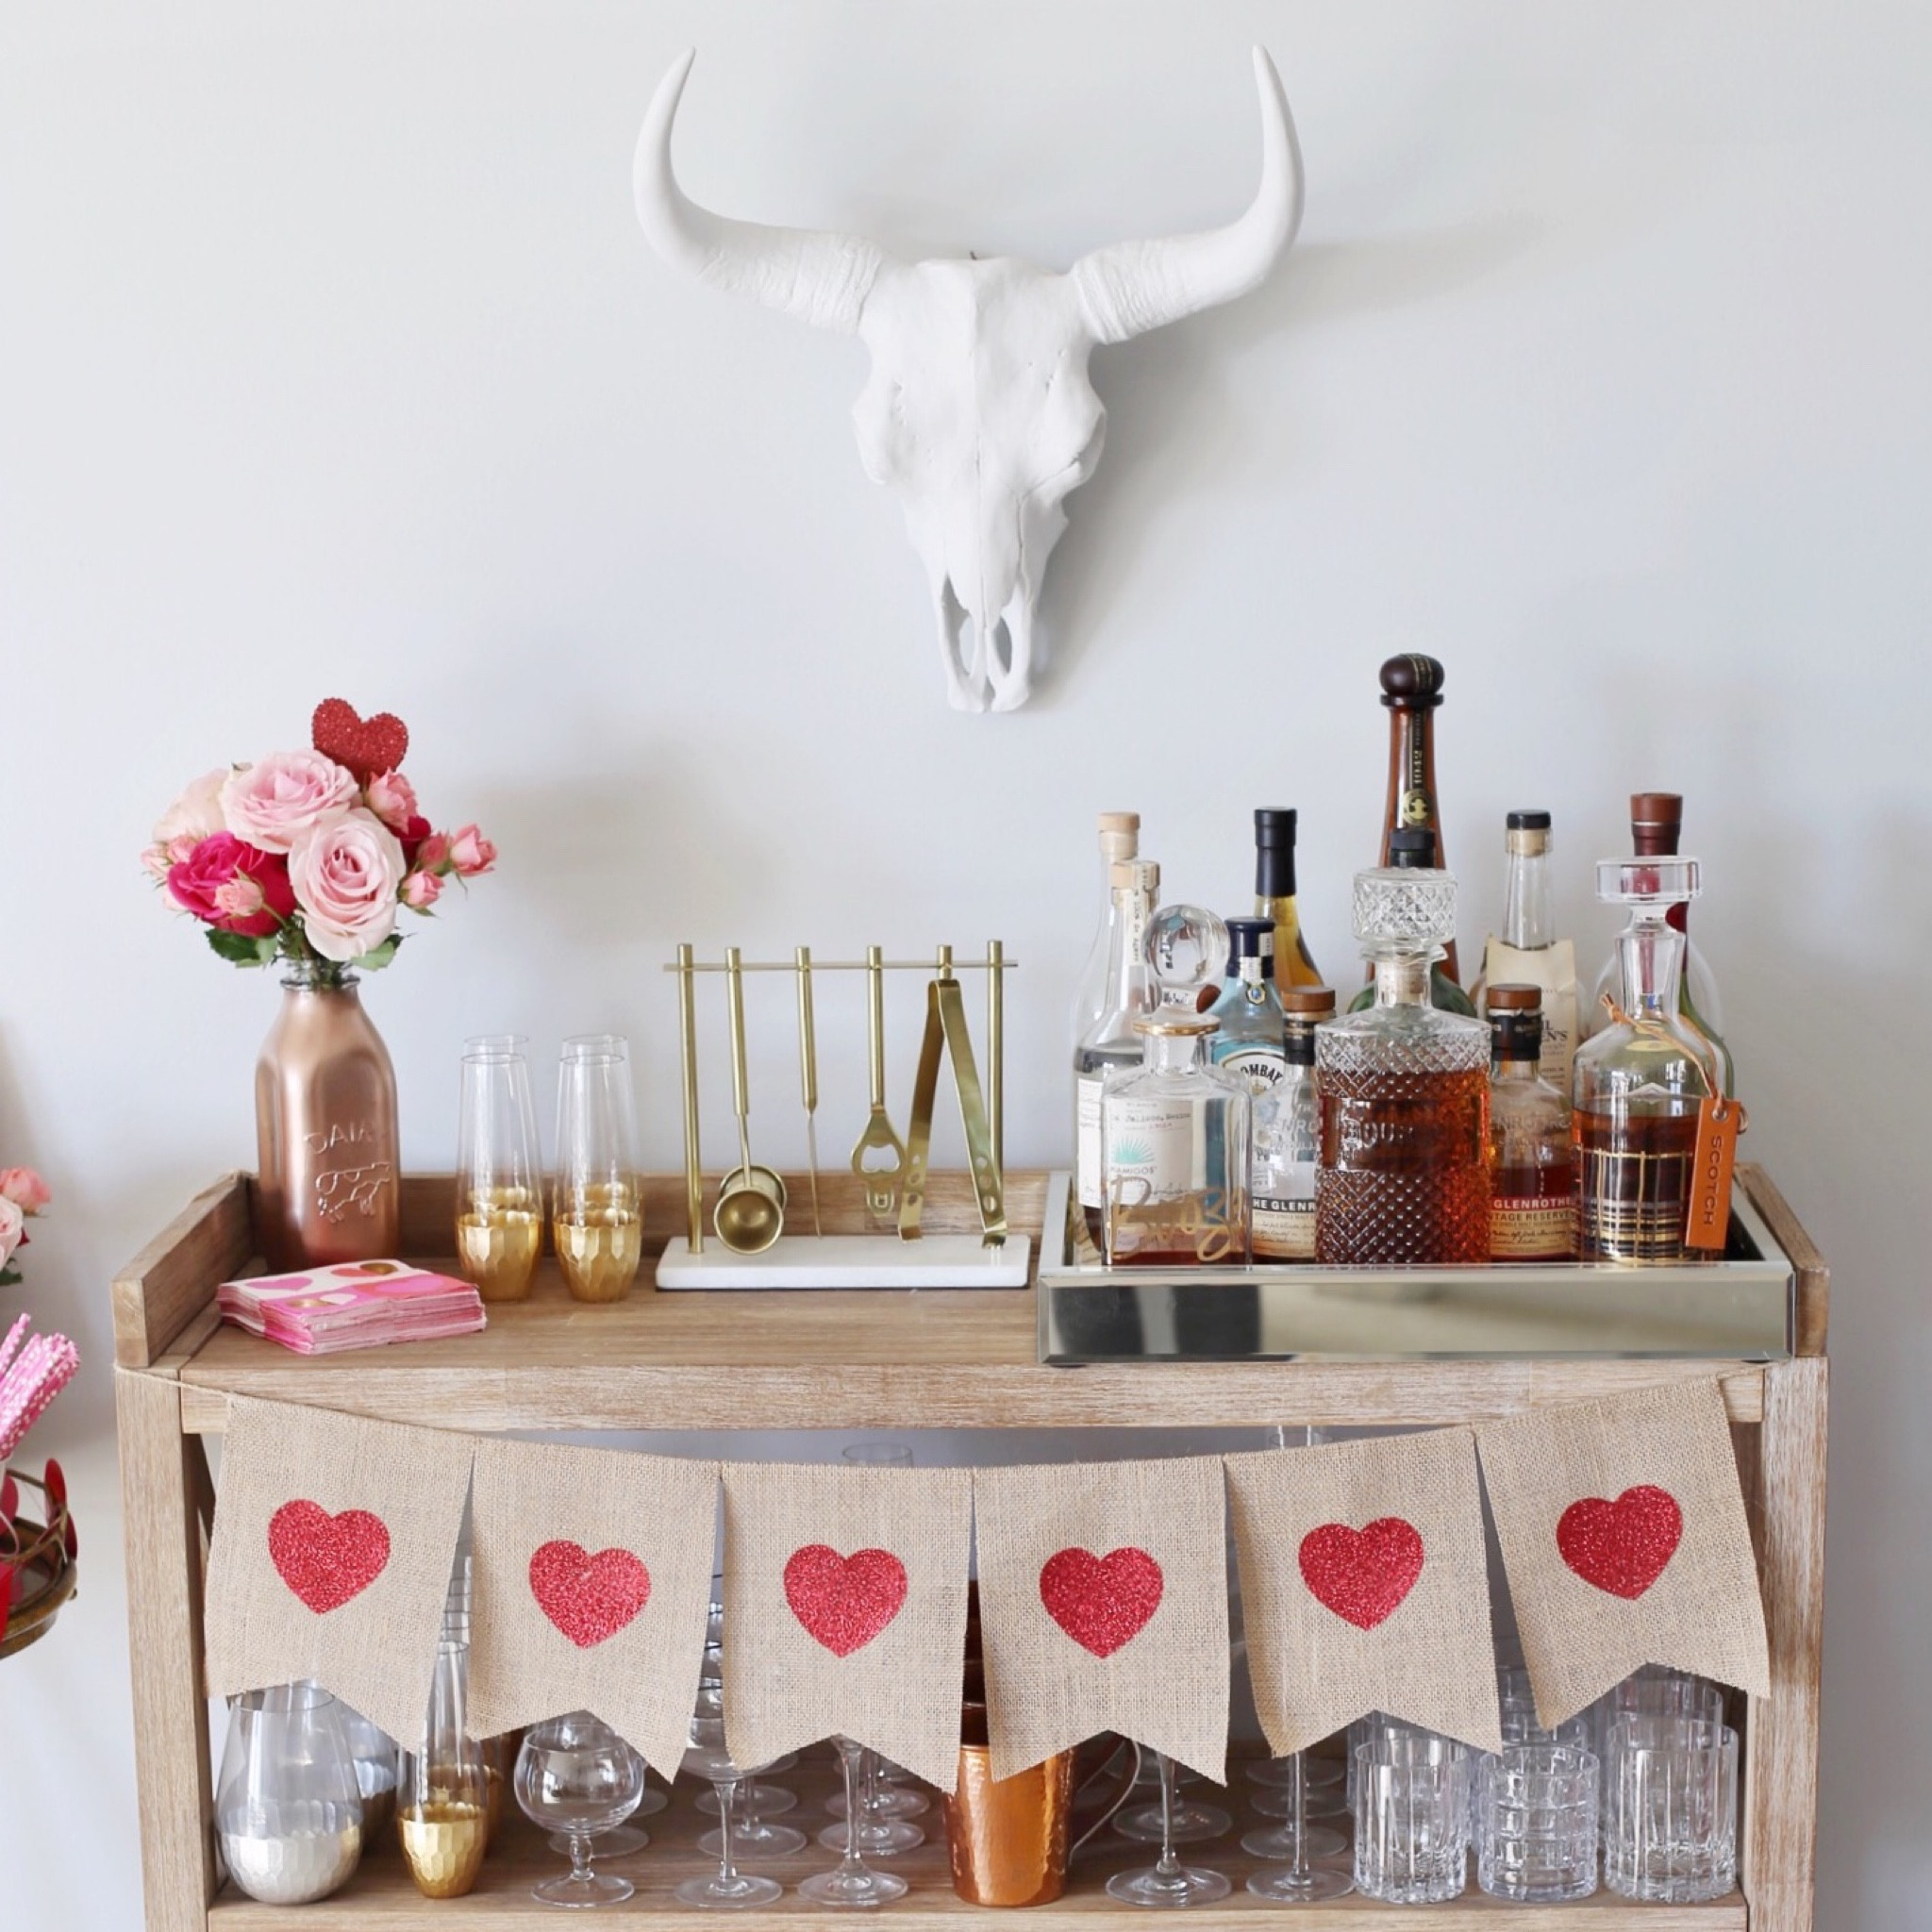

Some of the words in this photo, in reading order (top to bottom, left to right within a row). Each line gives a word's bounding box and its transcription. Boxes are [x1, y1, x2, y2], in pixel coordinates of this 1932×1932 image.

[1241, 1064, 1283, 1086] OMBAY
[1111, 1166, 1155, 1174] AMIGOS
[1704, 1135, 1722, 1225] SCOTCH
[1253, 1198, 1268, 1208] HE
[1271, 1201, 1317, 1211] GLENR
